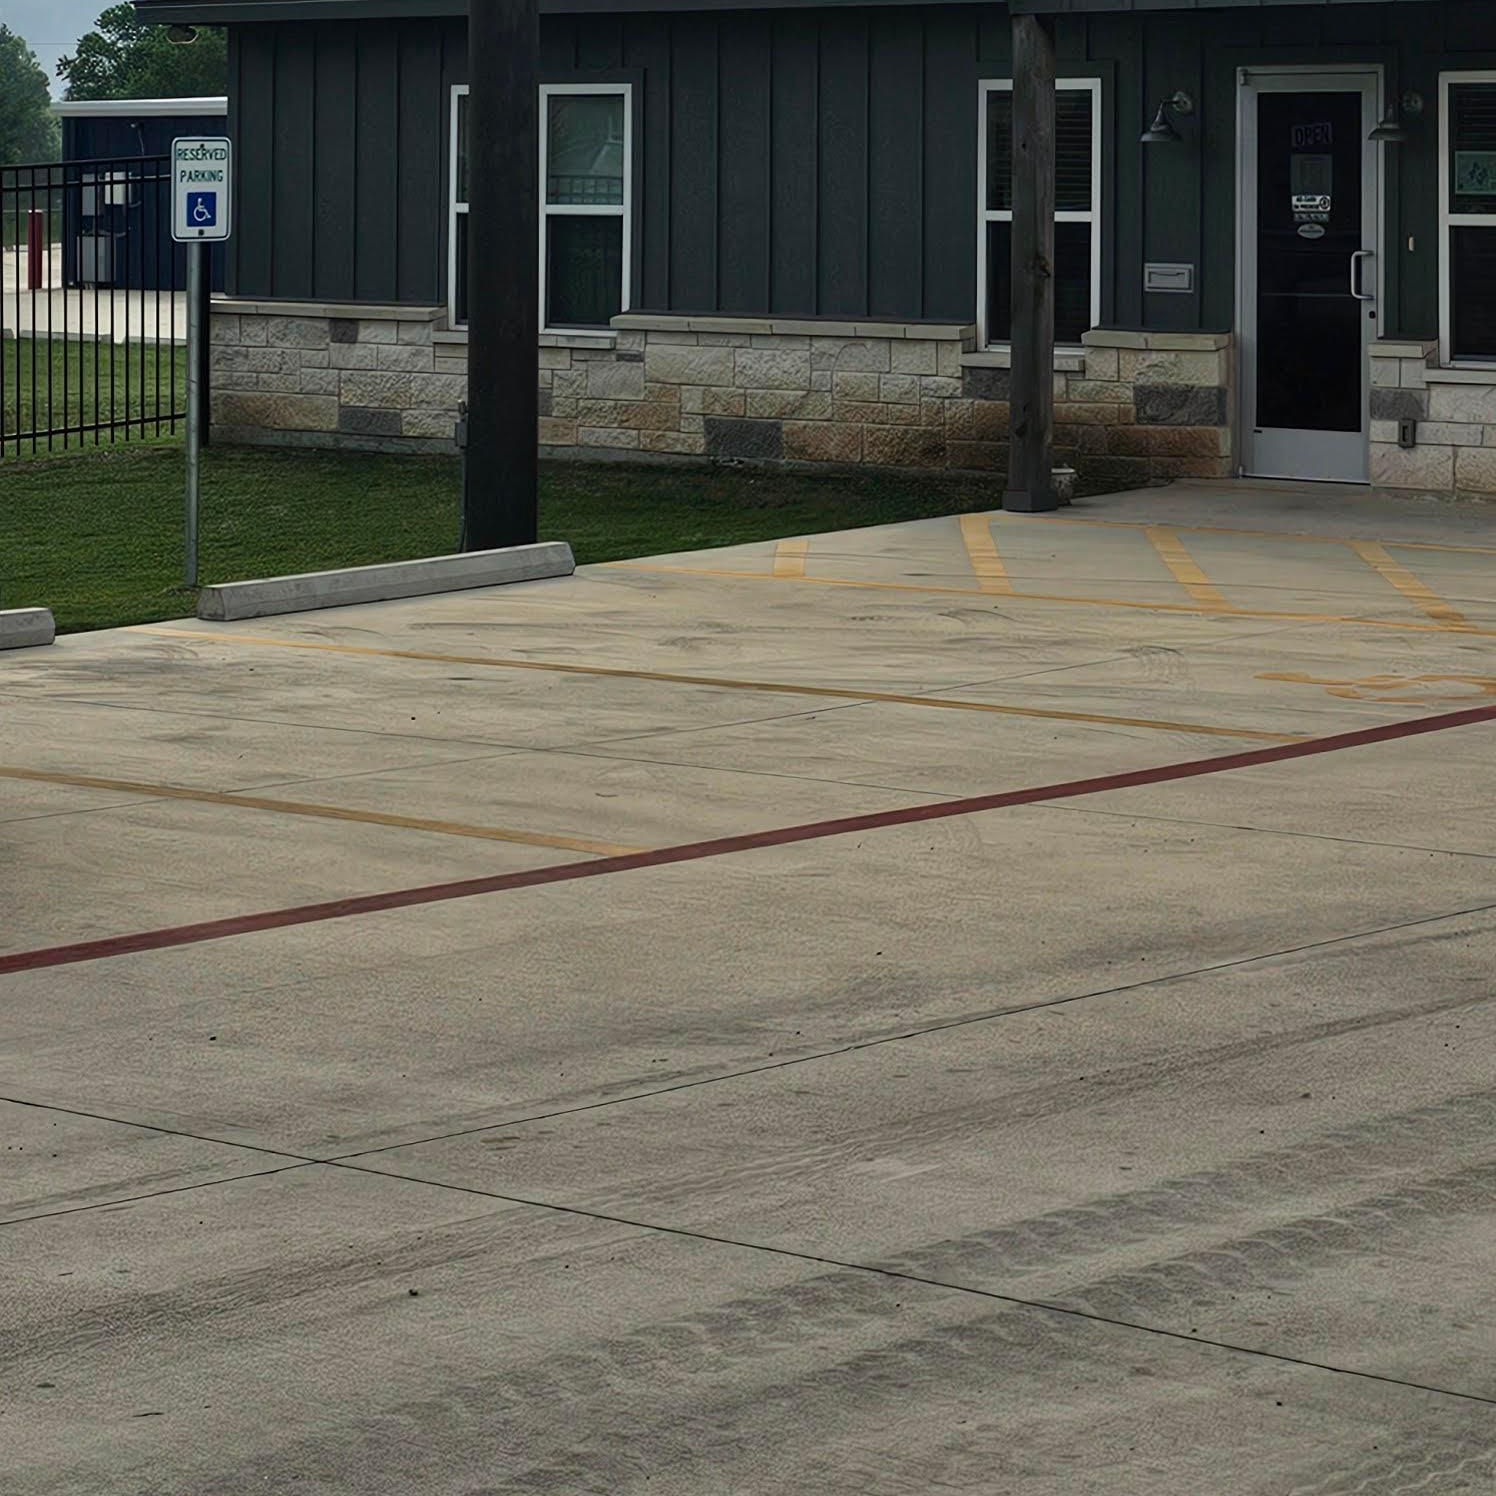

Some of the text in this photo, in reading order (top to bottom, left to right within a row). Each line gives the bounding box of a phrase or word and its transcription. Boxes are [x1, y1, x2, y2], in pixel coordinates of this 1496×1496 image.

[1295, 124, 1331, 145] OPEN
[177, 148, 227, 161] RESERVED
[180, 170, 224, 183] PARKING
